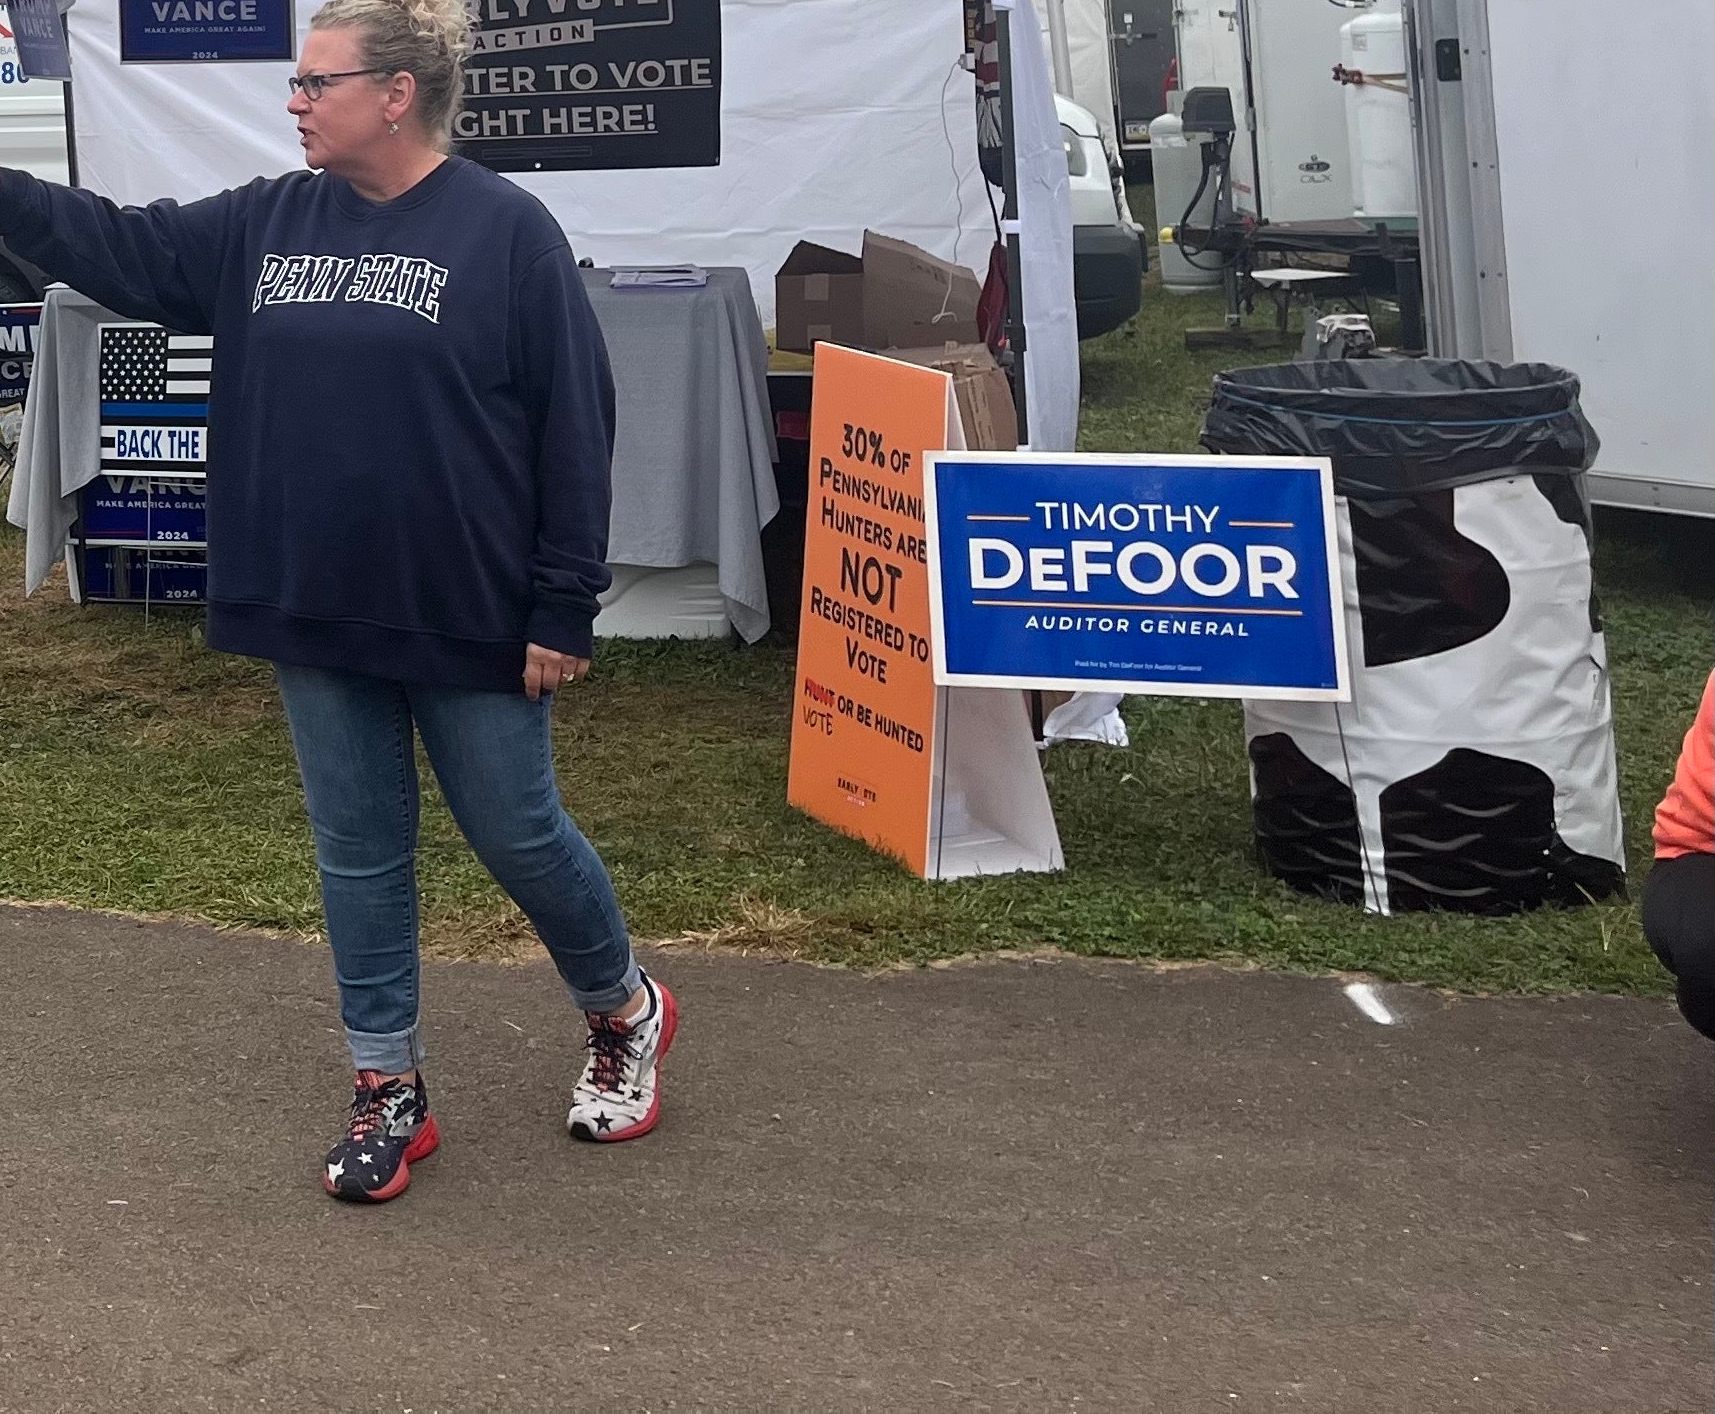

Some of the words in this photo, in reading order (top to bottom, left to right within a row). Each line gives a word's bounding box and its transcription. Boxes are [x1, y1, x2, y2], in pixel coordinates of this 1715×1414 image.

[151, 0, 258, 22] VANCE
[19, 18, 54, 39] VANCE
[144, 26, 167, 34] MAKE
[169, 26, 206, 34] AMERICA
[473, 23, 585, 51] ACTION
[192, 52, 219, 60] 2024
[546, 63, 599, 90] TO
[608, 58, 713, 88] VOTE
[542, 104, 657, 135] HERE!
[252, 254, 355, 314] PENN
[344, 254, 449, 325] STATE
[116, 429, 164, 459] BACK
[169, 428, 200, 459] THE
[842, 423, 886, 468] 30%
[890, 449, 911, 475] OF
[96, 500, 124, 508] MAKE
[126, 500, 172, 509] AMERICA
[174, 501, 206, 510] GREAT
[819, 457, 925, 524] PENNSYLVANI
[822, 496, 893, 551] HUNTERS
[896, 532, 927, 565] ARE
[1034, 500, 1220, 534] TIMOTHY
[157, 531, 189, 540] 2024
[166, 590, 198, 598] 2024
[840, 547, 903, 613] NOT
[811, 585, 904, 652] REGISTERED
[908, 632, 929, 662] TO
[1024, 614, 1130, 634] AUDITOR
[1140, 618, 1250, 638] GENERAL
[846, 636, 888, 685] VOTE
[802, 704, 834, 736] VOTE
[837, 694, 854, 717] OR
[856, 704, 873, 728] BE
[874, 713, 924, 753] HUNTED
